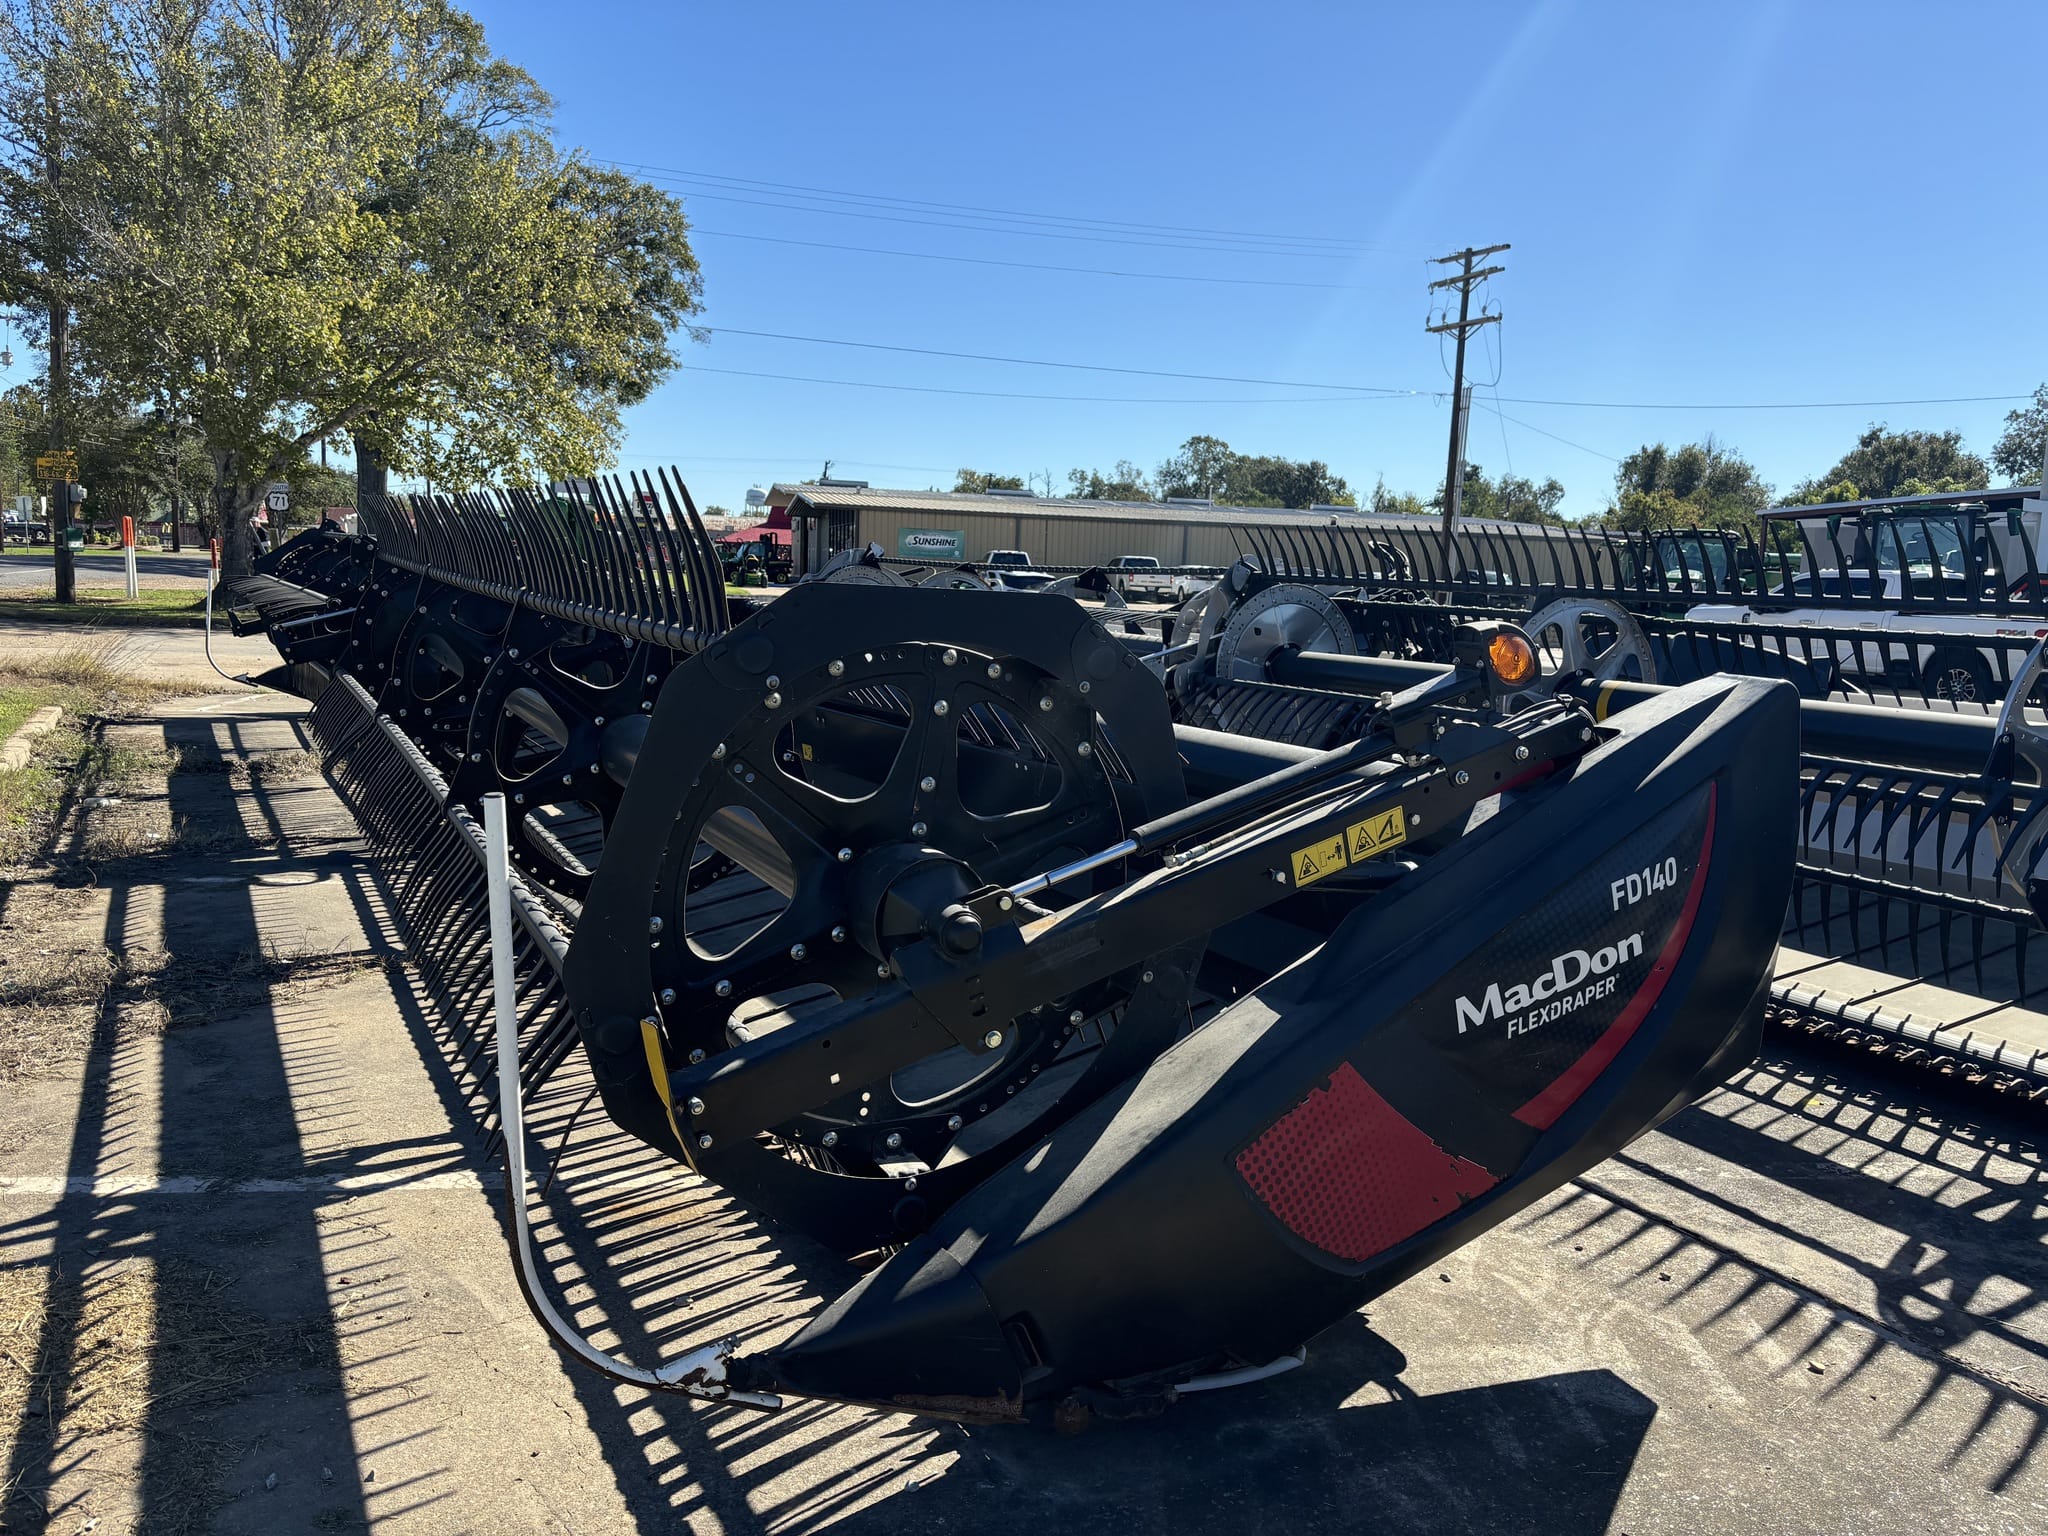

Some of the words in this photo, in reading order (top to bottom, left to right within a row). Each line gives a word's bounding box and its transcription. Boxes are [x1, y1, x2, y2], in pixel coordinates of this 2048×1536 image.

[272, 496, 286, 507] 71
[912, 536, 957, 547] SUNSHINE
[1610, 856, 1677, 911] FD140
[1455, 931, 1643, 1034] MacDon
[1507, 976, 1616, 1039] FLEXDRAPER
